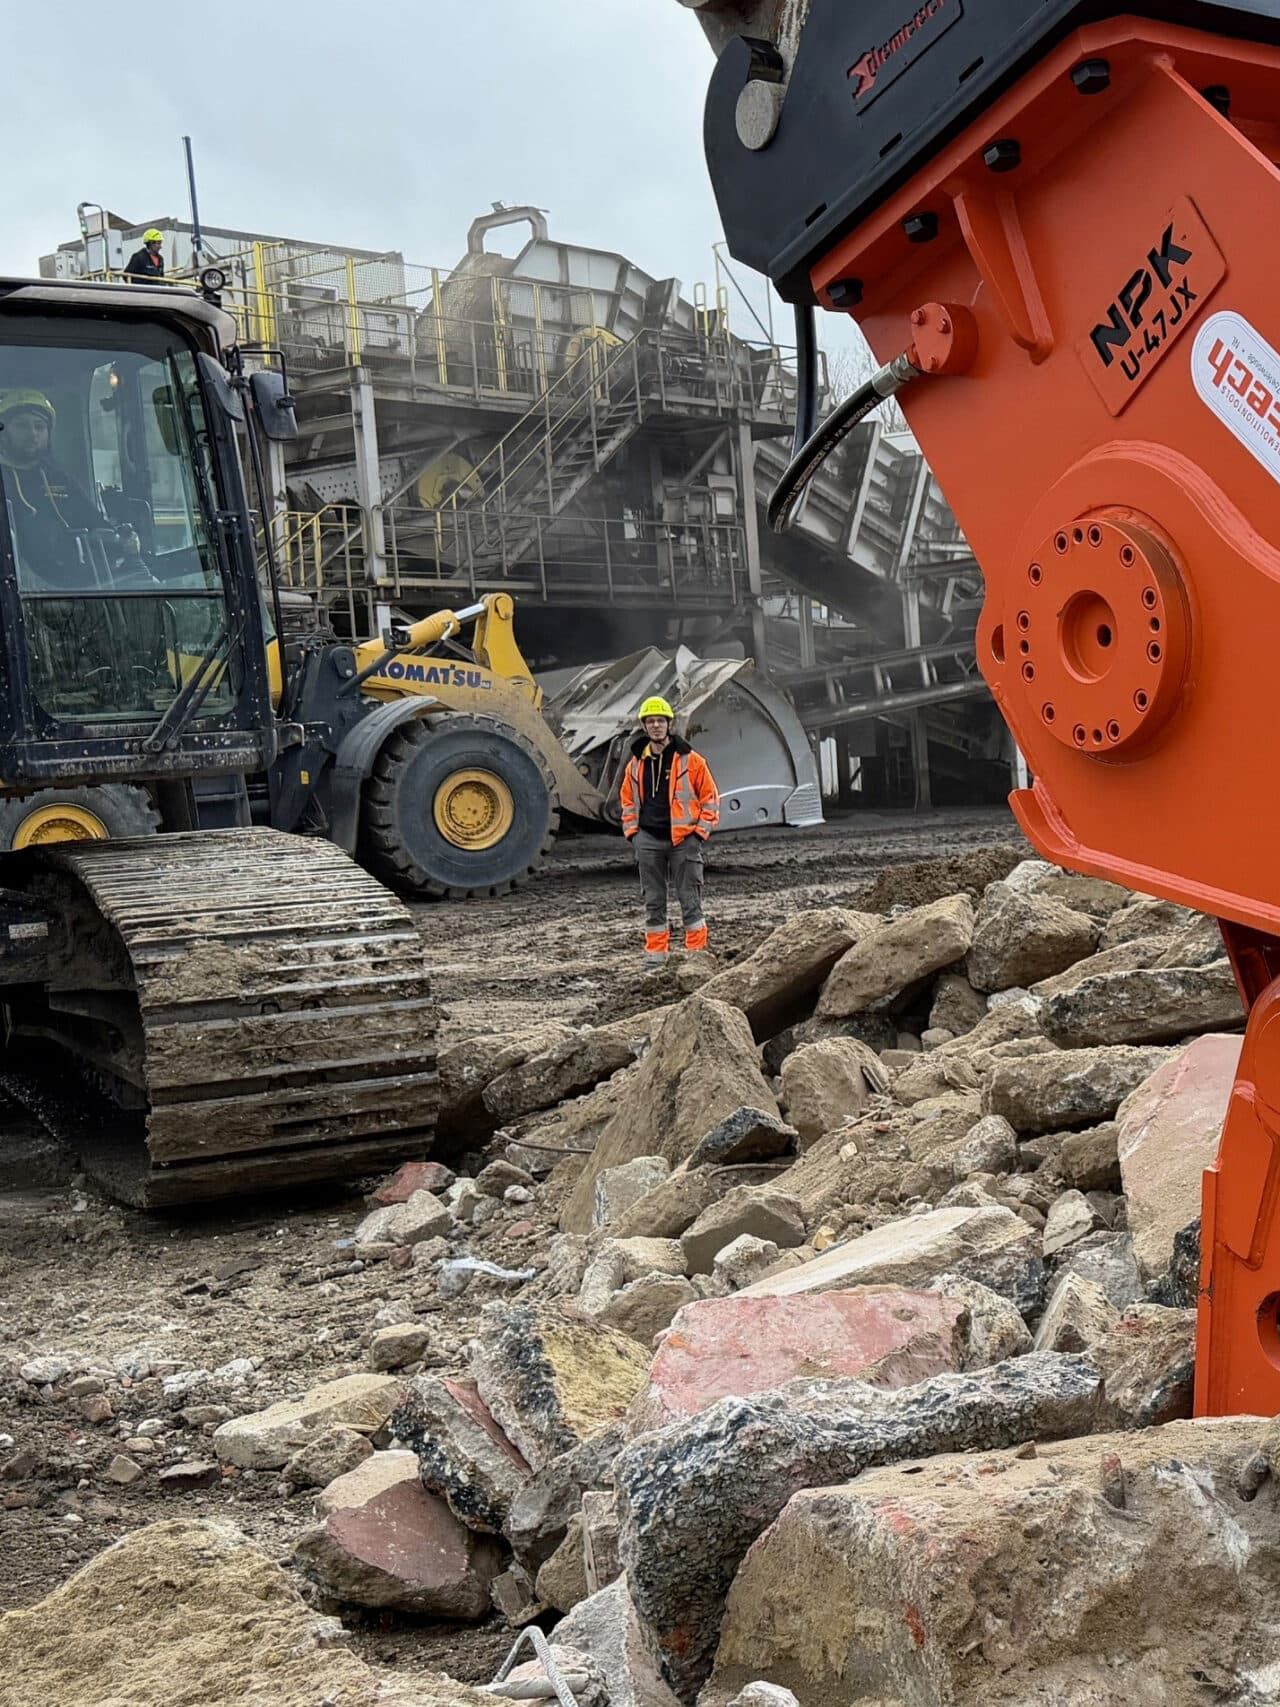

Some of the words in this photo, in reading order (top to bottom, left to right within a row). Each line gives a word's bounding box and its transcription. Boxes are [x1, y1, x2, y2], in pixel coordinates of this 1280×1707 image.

[867, 0, 945, 76] demtec
[1089, 222, 1192, 367] NPK
[1120, 277, 1198, 382] U-47JX
